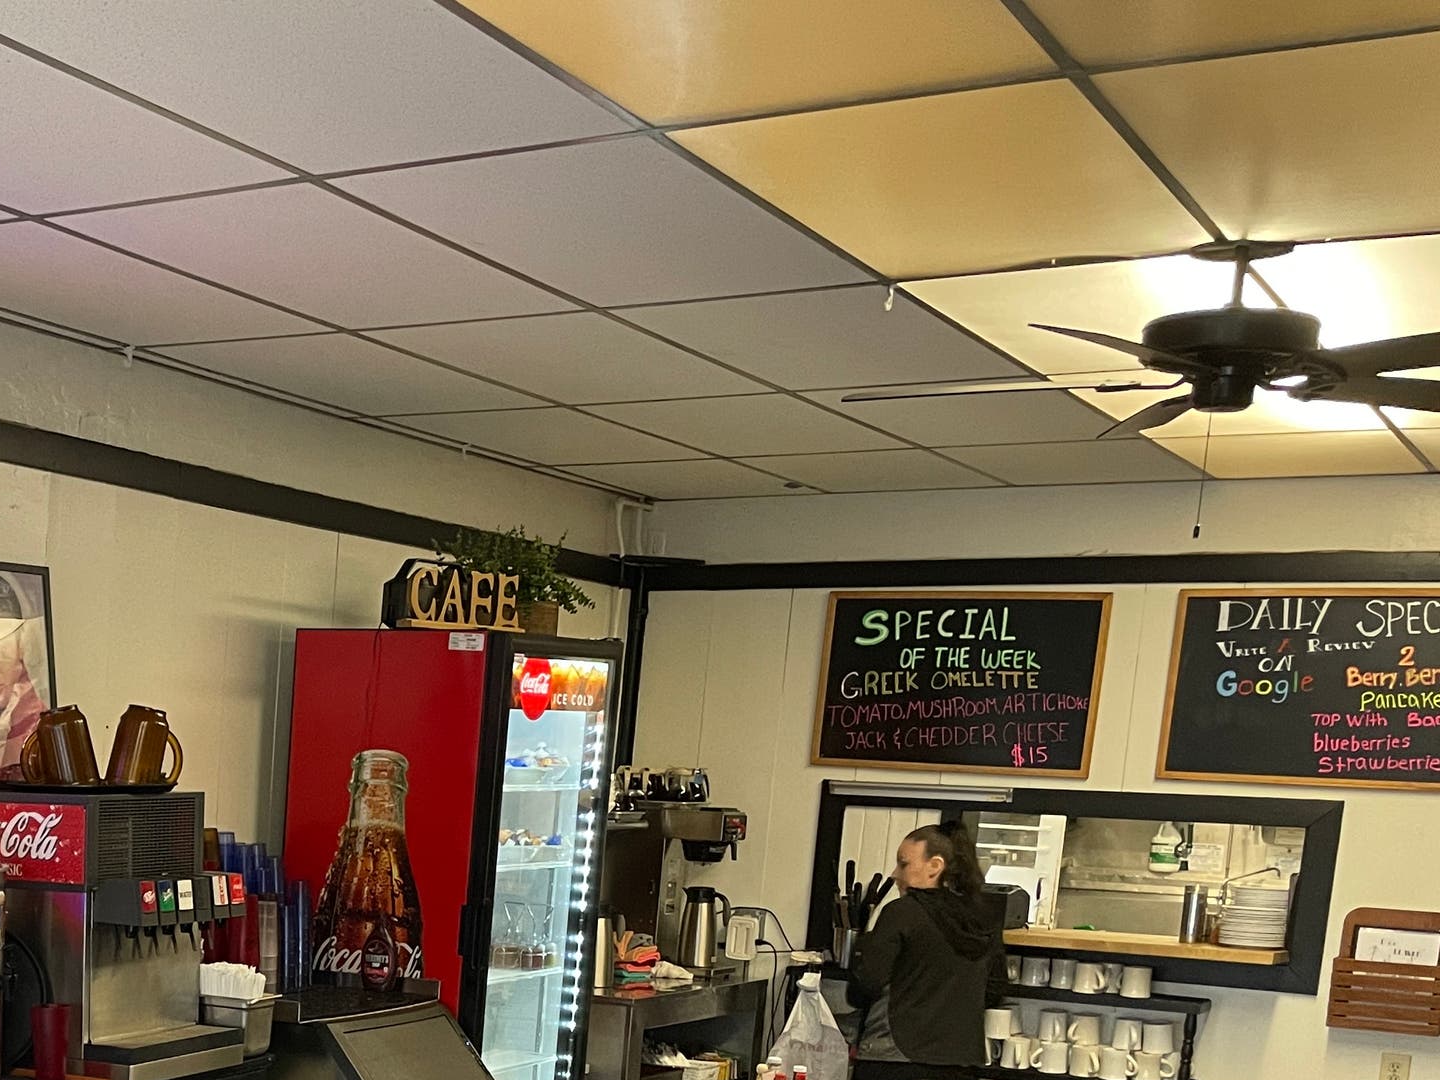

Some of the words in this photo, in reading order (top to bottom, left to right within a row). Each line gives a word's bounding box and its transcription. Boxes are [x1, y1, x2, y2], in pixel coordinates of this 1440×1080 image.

[411, 566, 520, 628] CAFE
[854, 606, 1017, 646] SPECIAL
[1216, 598, 1334, 635] DAILY
[900, 648, 926, 669] OF
[935, 646, 970, 669] THE
[981, 648, 1041, 670] WEEK
[1258, 654, 1296, 673] ON
[1398, 646, 1416, 666] 2
[841, 670, 920, 699] GREEK
[931, 671, 1040, 690] OMELETTE
[1215, 670, 1314, 704] Google
[553, 693, 568, 706] ICE
[571, 694, 594, 707] COLD
[1311, 713, 1341, 727] TOP
[845, 731, 886, 750] JACK
[1003, 721, 1070, 746] CHEESE
[1313, 732, 1411, 752] blueberries
